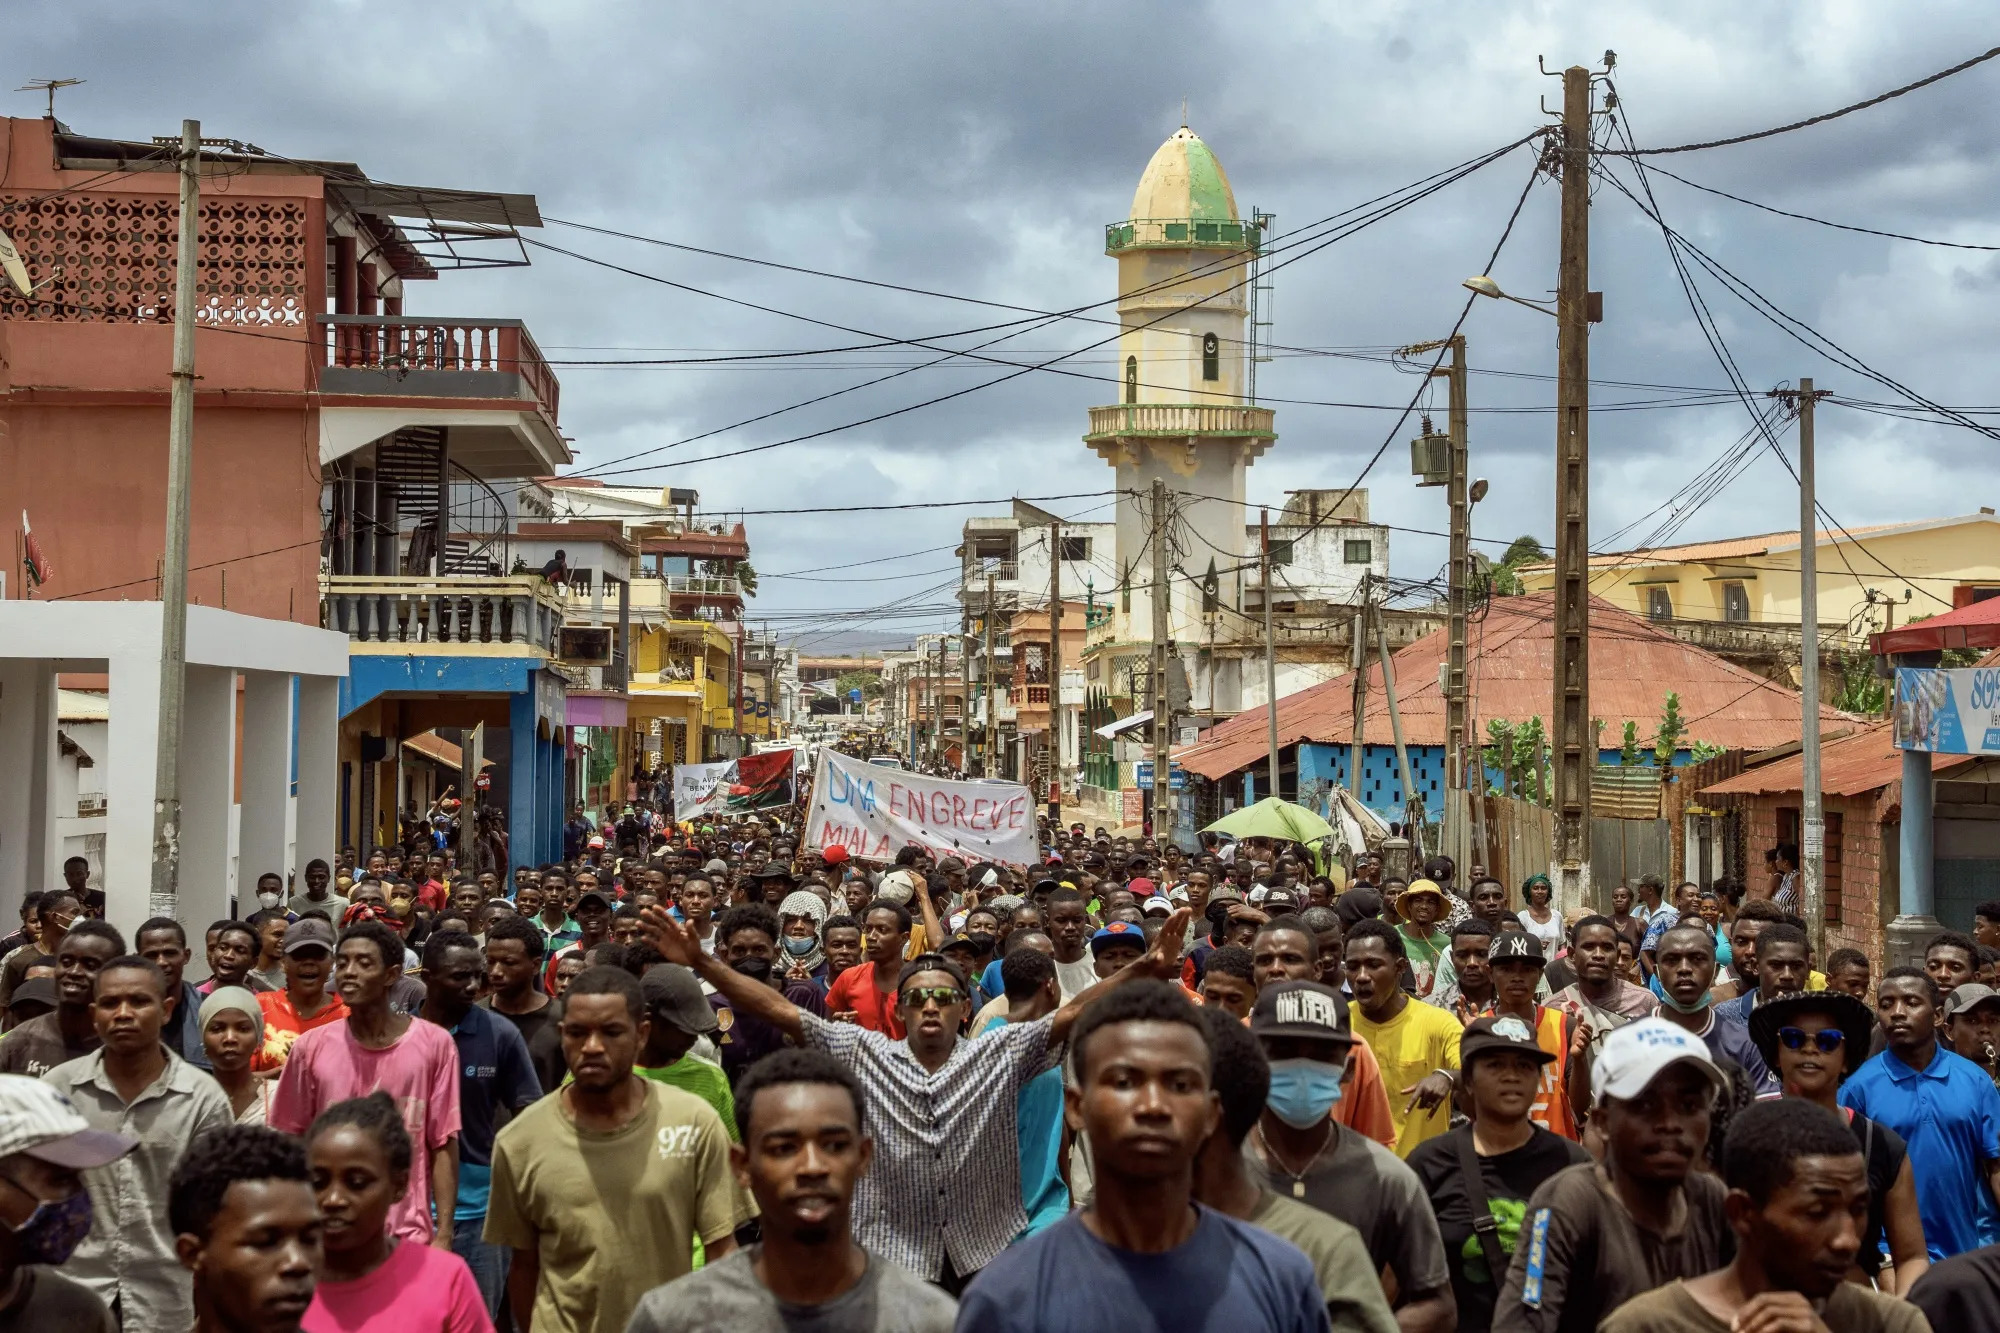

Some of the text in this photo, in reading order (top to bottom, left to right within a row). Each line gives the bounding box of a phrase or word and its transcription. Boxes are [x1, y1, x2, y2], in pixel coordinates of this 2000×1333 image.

[889, 783, 1025, 830] ENGREVE
[820, 820, 890, 858] MIALA
[1510, 936, 1528, 956] NY
